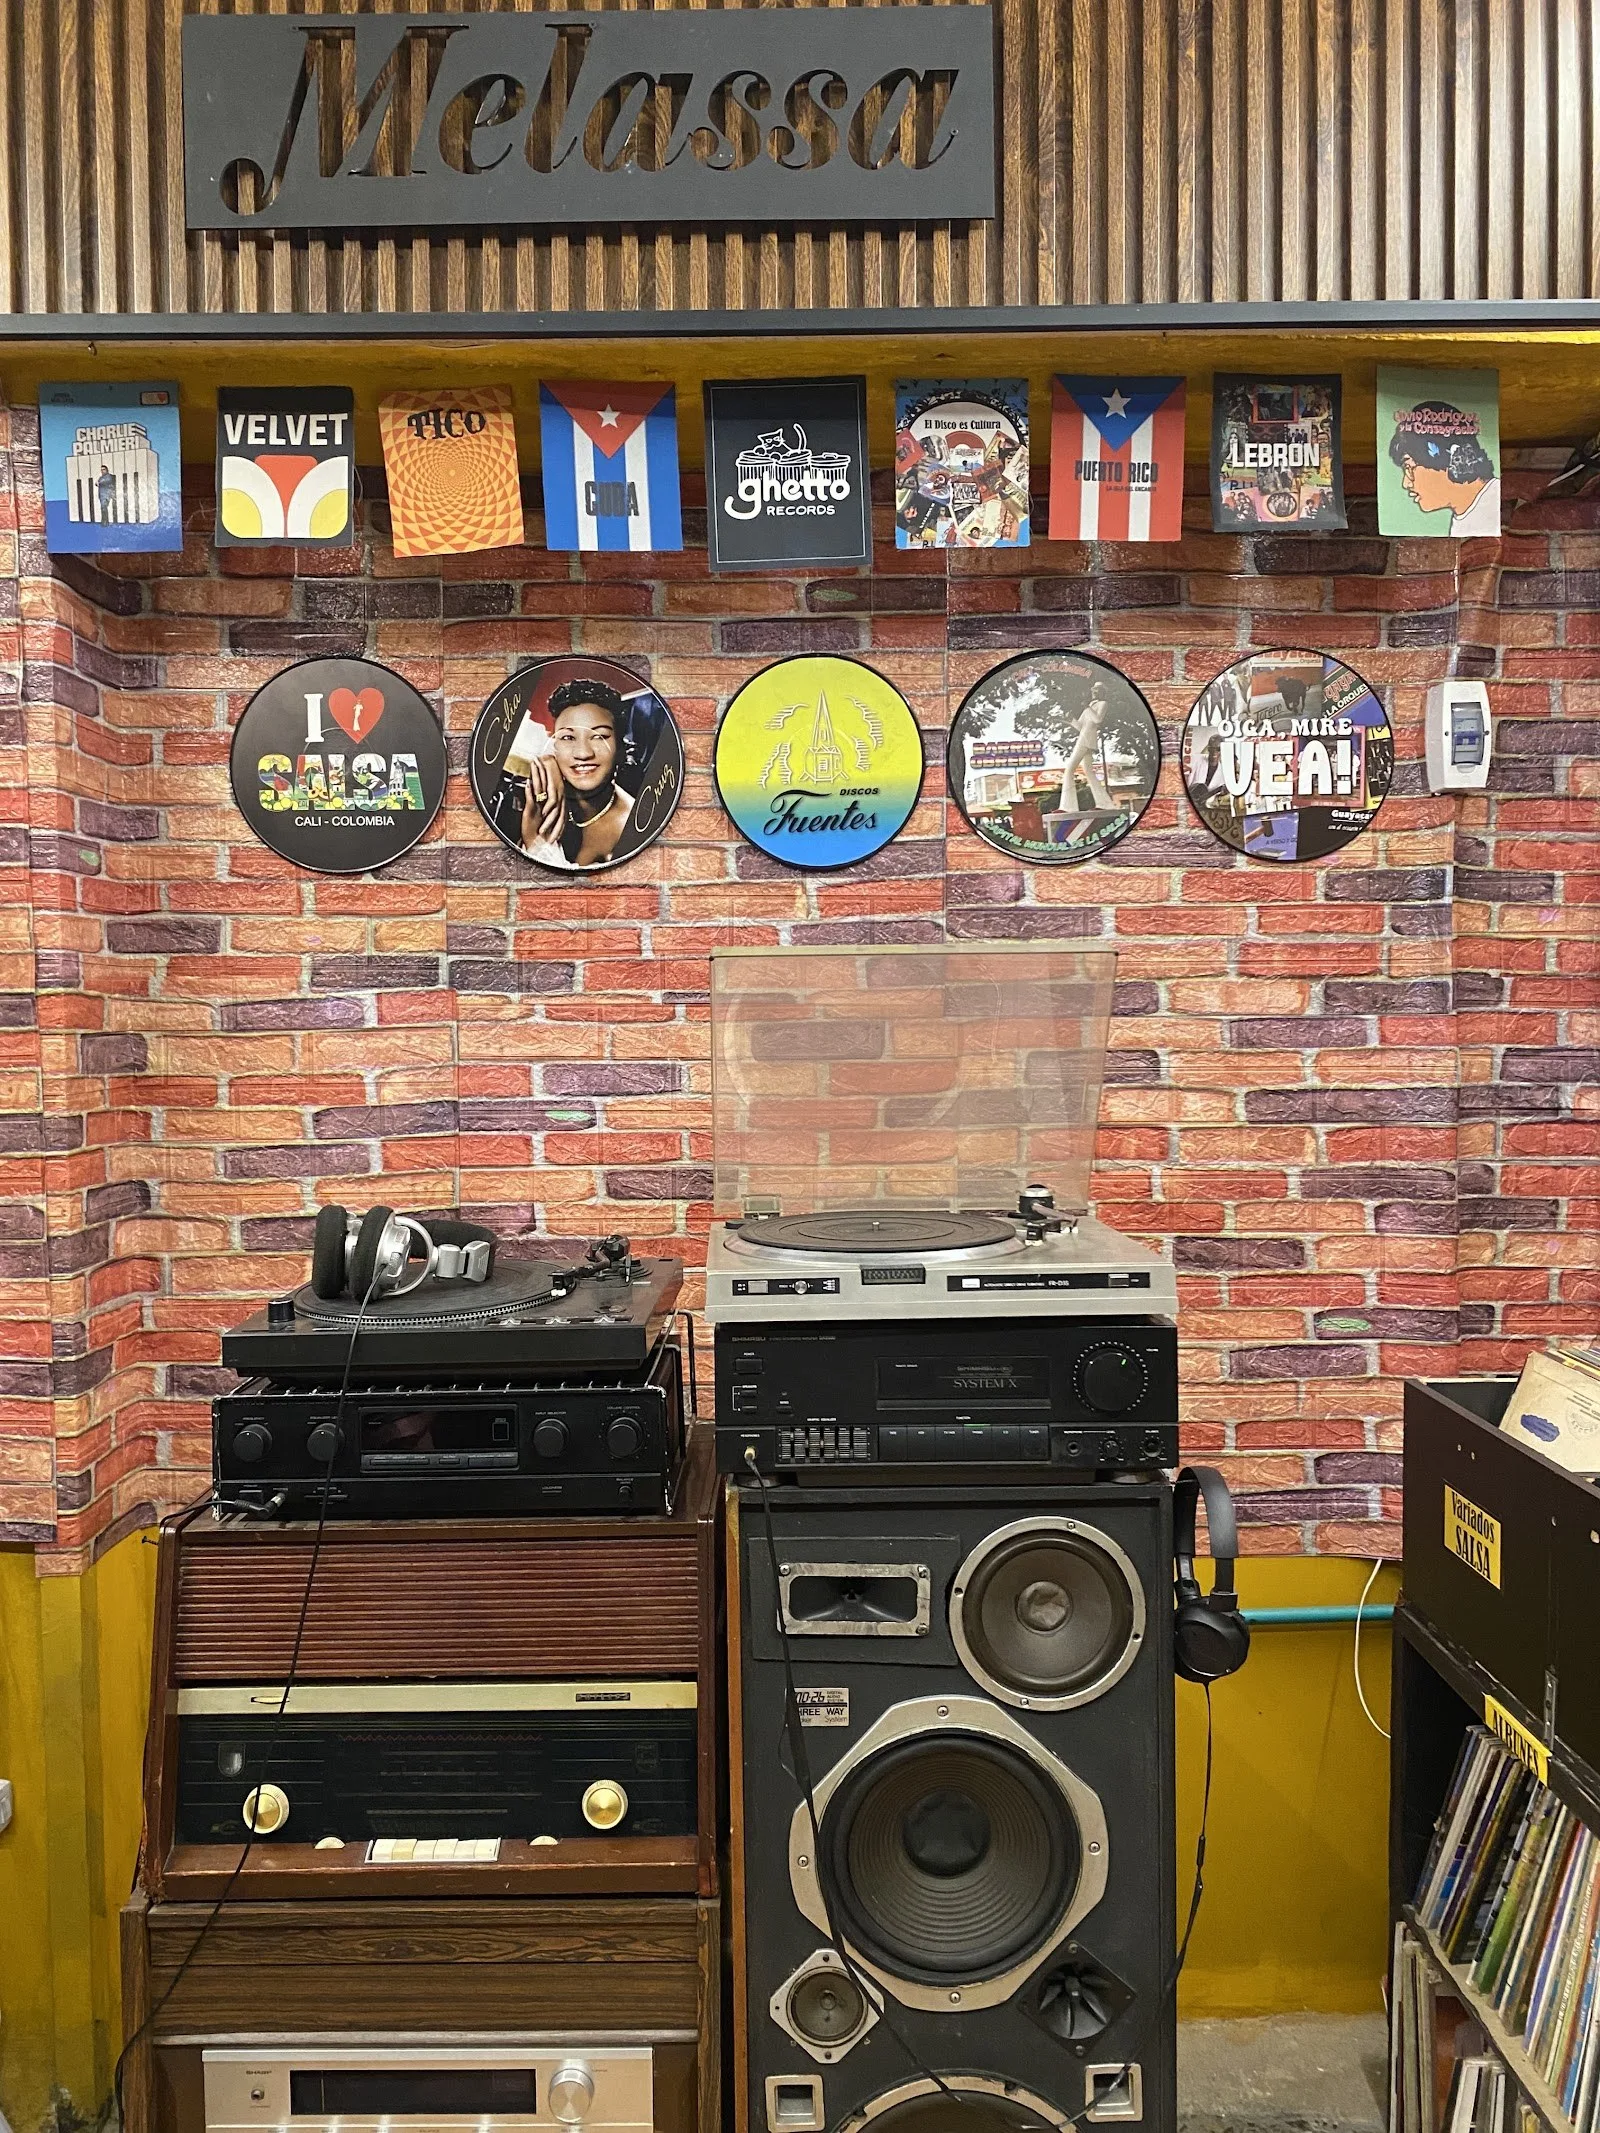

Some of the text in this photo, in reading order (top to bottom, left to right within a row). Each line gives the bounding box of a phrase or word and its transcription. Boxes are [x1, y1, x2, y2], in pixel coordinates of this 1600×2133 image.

[220, 23, 960, 216] Melassa
[77, 422, 139, 441] CHARLIE
[224, 412, 349, 446] VELVET
[407, 408, 486, 441] TICO
[924, 419, 1001, 430] El Disco es Cultura
[72, 436, 139, 456] PALMIERI
[1232, 443, 1320, 468] LEBRON
[1075, 460, 1159, 483] PUERTO RICO
[584, 480, 640, 518] CUBA
[724, 469, 851, 520] ghetto
[766, 505, 836, 516] RECORDS
[303, 693, 325, 743] I
[484, 686, 522, 764] Celia
[1290, 718, 1353, 737] MIRE
[1326, 706, 1338, 717] LA
[258, 753, 426, 812] SALSA
[1220, 739, 1353, 797] VEA!
[634, 763, 675, 833] Cruz
[840, 787, 879, 796] DISCOS
[295, 816, 322, 827] CALI
[331, 815, 395, 827] COLOMBIA
[763, 789, 878, 836] Fuentes
[953, 1378, 1017, 1388] SYSTEM X
[1451, 1490, 1495, 1544] Variados
[1455, 1525, 1492, 1581] SALSA
[826, 1707, 845, 1716] WAY
